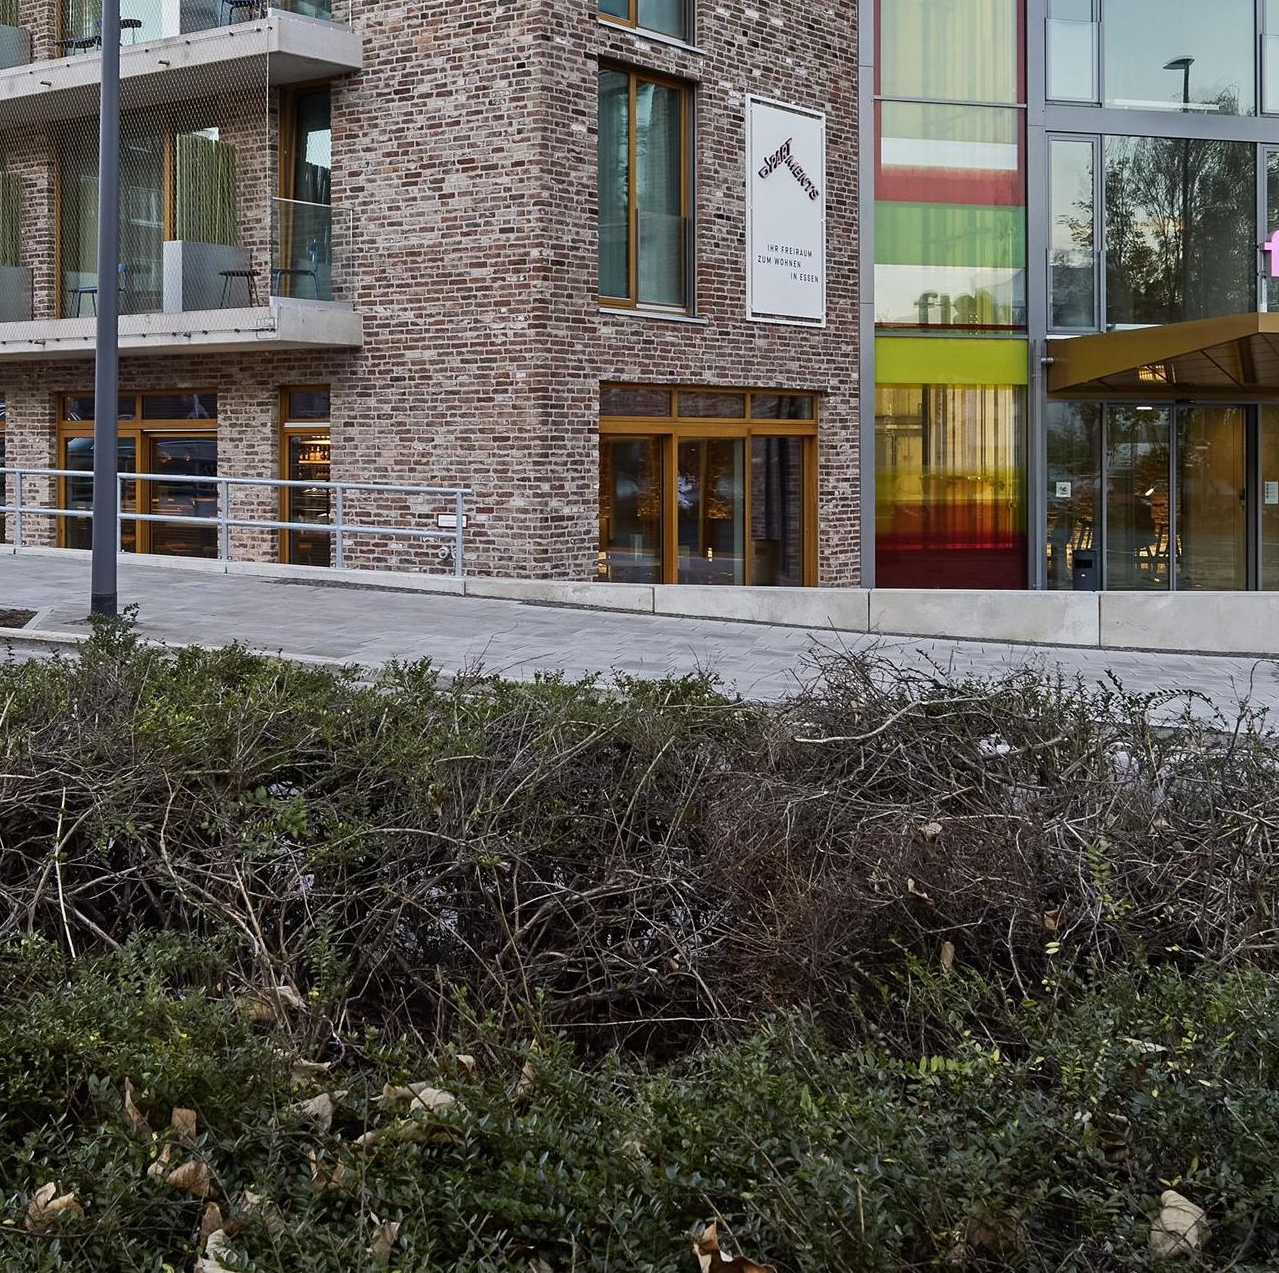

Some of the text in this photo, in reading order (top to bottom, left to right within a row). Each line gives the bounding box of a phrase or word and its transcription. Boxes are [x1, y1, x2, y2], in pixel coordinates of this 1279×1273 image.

[767, 244, 812, 257] IHR FREIRAUM
[757, 255, 801, 268] ZUM WOHNEN
[790, 272, 819, 283] IN ESSEN
